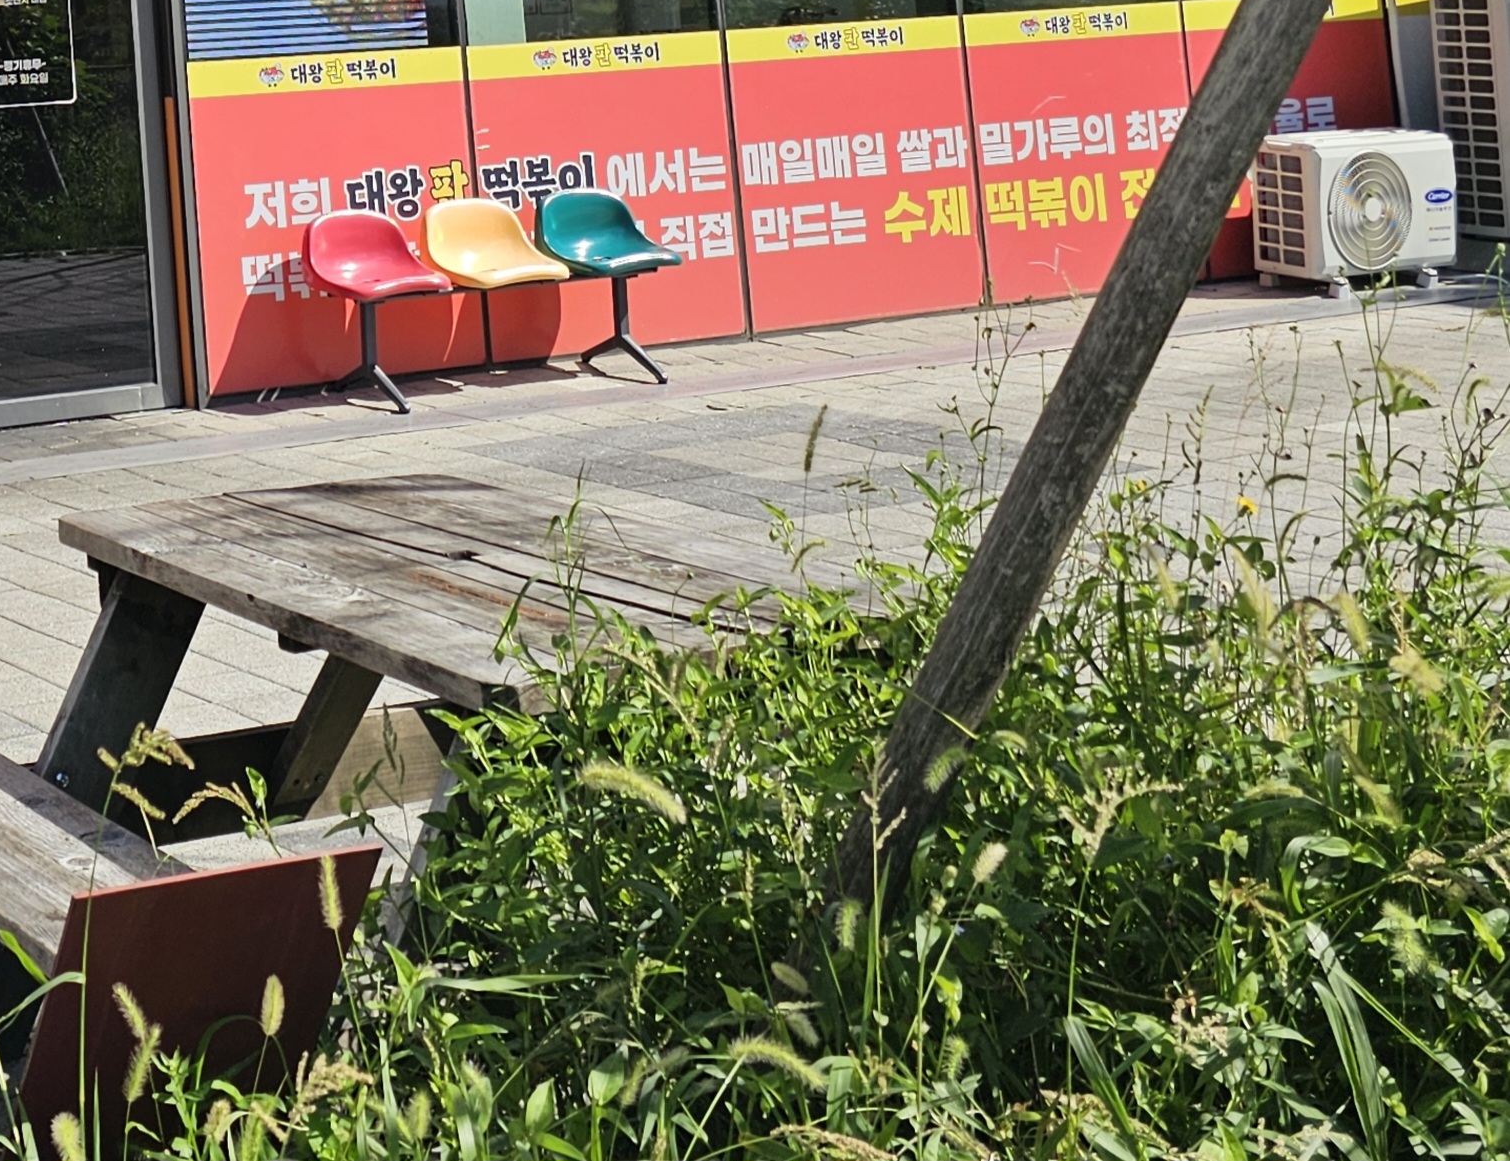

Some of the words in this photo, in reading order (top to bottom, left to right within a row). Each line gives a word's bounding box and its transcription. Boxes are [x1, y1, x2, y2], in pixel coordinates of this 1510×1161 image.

[244, 177, 331, 230] 저희
[741, 133, 887, 186] 매일매일
[896, 127, 968, 173] 쌀과
[980, 113, 1116, 165] 밀가루의
[751, 202, 867, 254] 만드는
[884, 184, 972, 244] 수제
[984, 173, 1108, 232] 떡볶이
